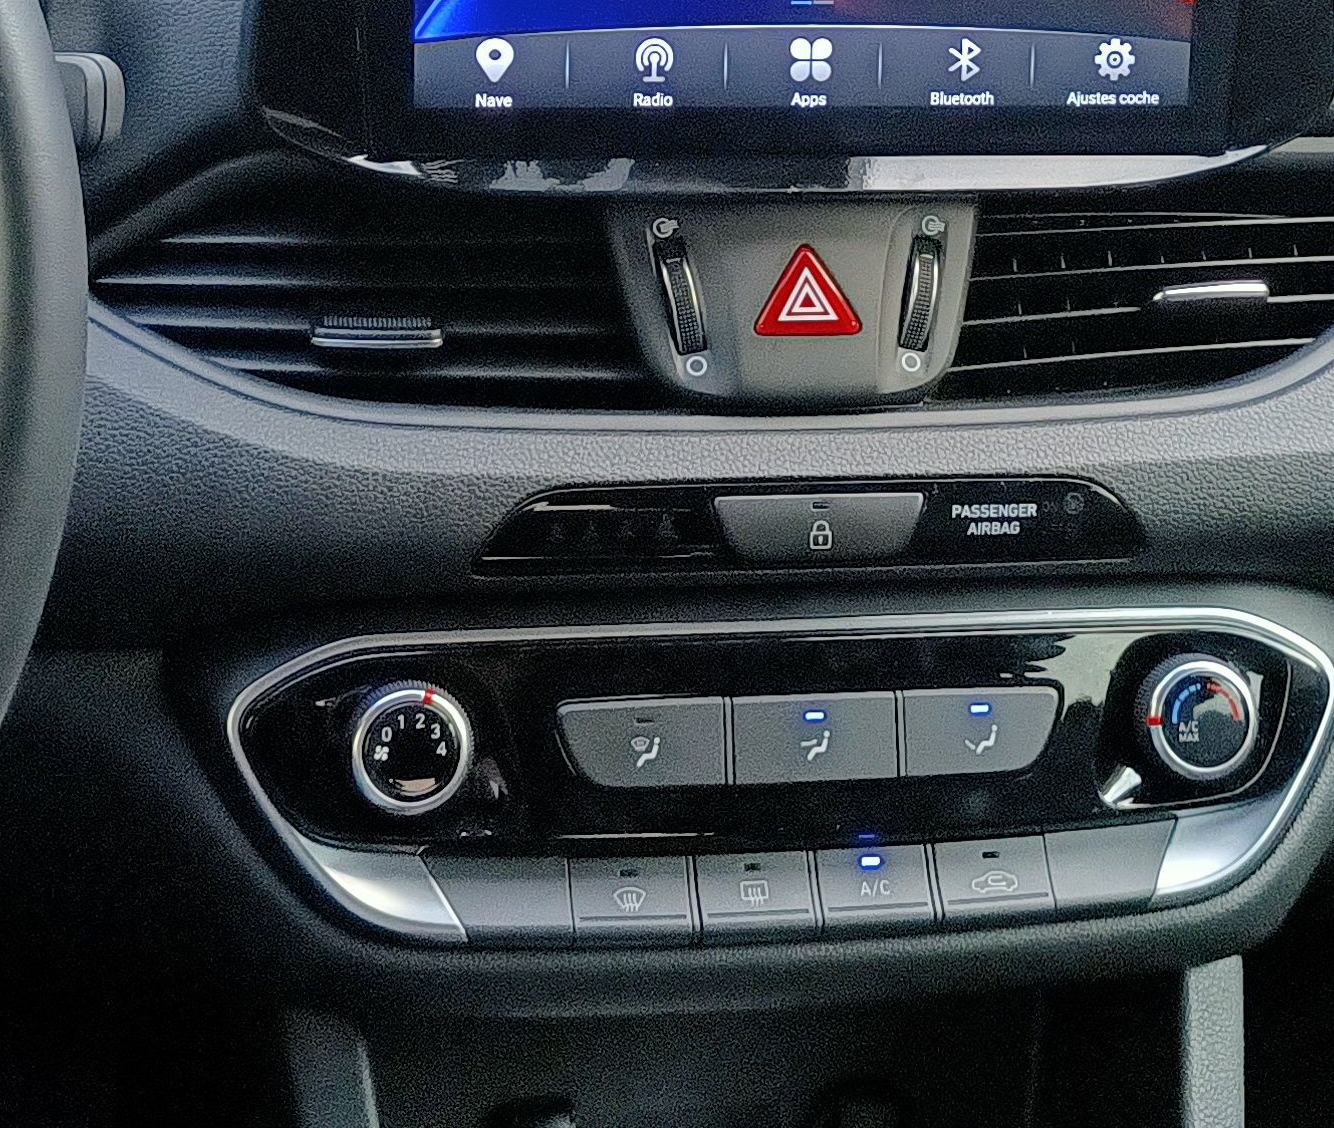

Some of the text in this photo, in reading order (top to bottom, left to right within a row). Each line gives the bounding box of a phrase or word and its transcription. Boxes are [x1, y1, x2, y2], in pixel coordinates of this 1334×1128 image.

[475, 93, 513, 108] Nave
[633, 92, 673, 107] Radio
[791, 92, 827, 108] Apps
[930, 91, 994, 106] Bluetooth
[1066, 90, 1160, 107] Ajustes coche
[951, 503, 1038, 519] PASSENGER
[966, 521, 1021, 536] AIRBAG
[397, 714, 405, 729] 1
[415, 713, 426, 729] 2
[1178, 721, 1199, 732] A/C
[381, 726, 393, 743] 0
[430, 723, 441, 740] 3
[1178, 733, 1200, 743] MAX
[436, 741, 447, 756] 4
[860, 879, 891, 897] A/C
